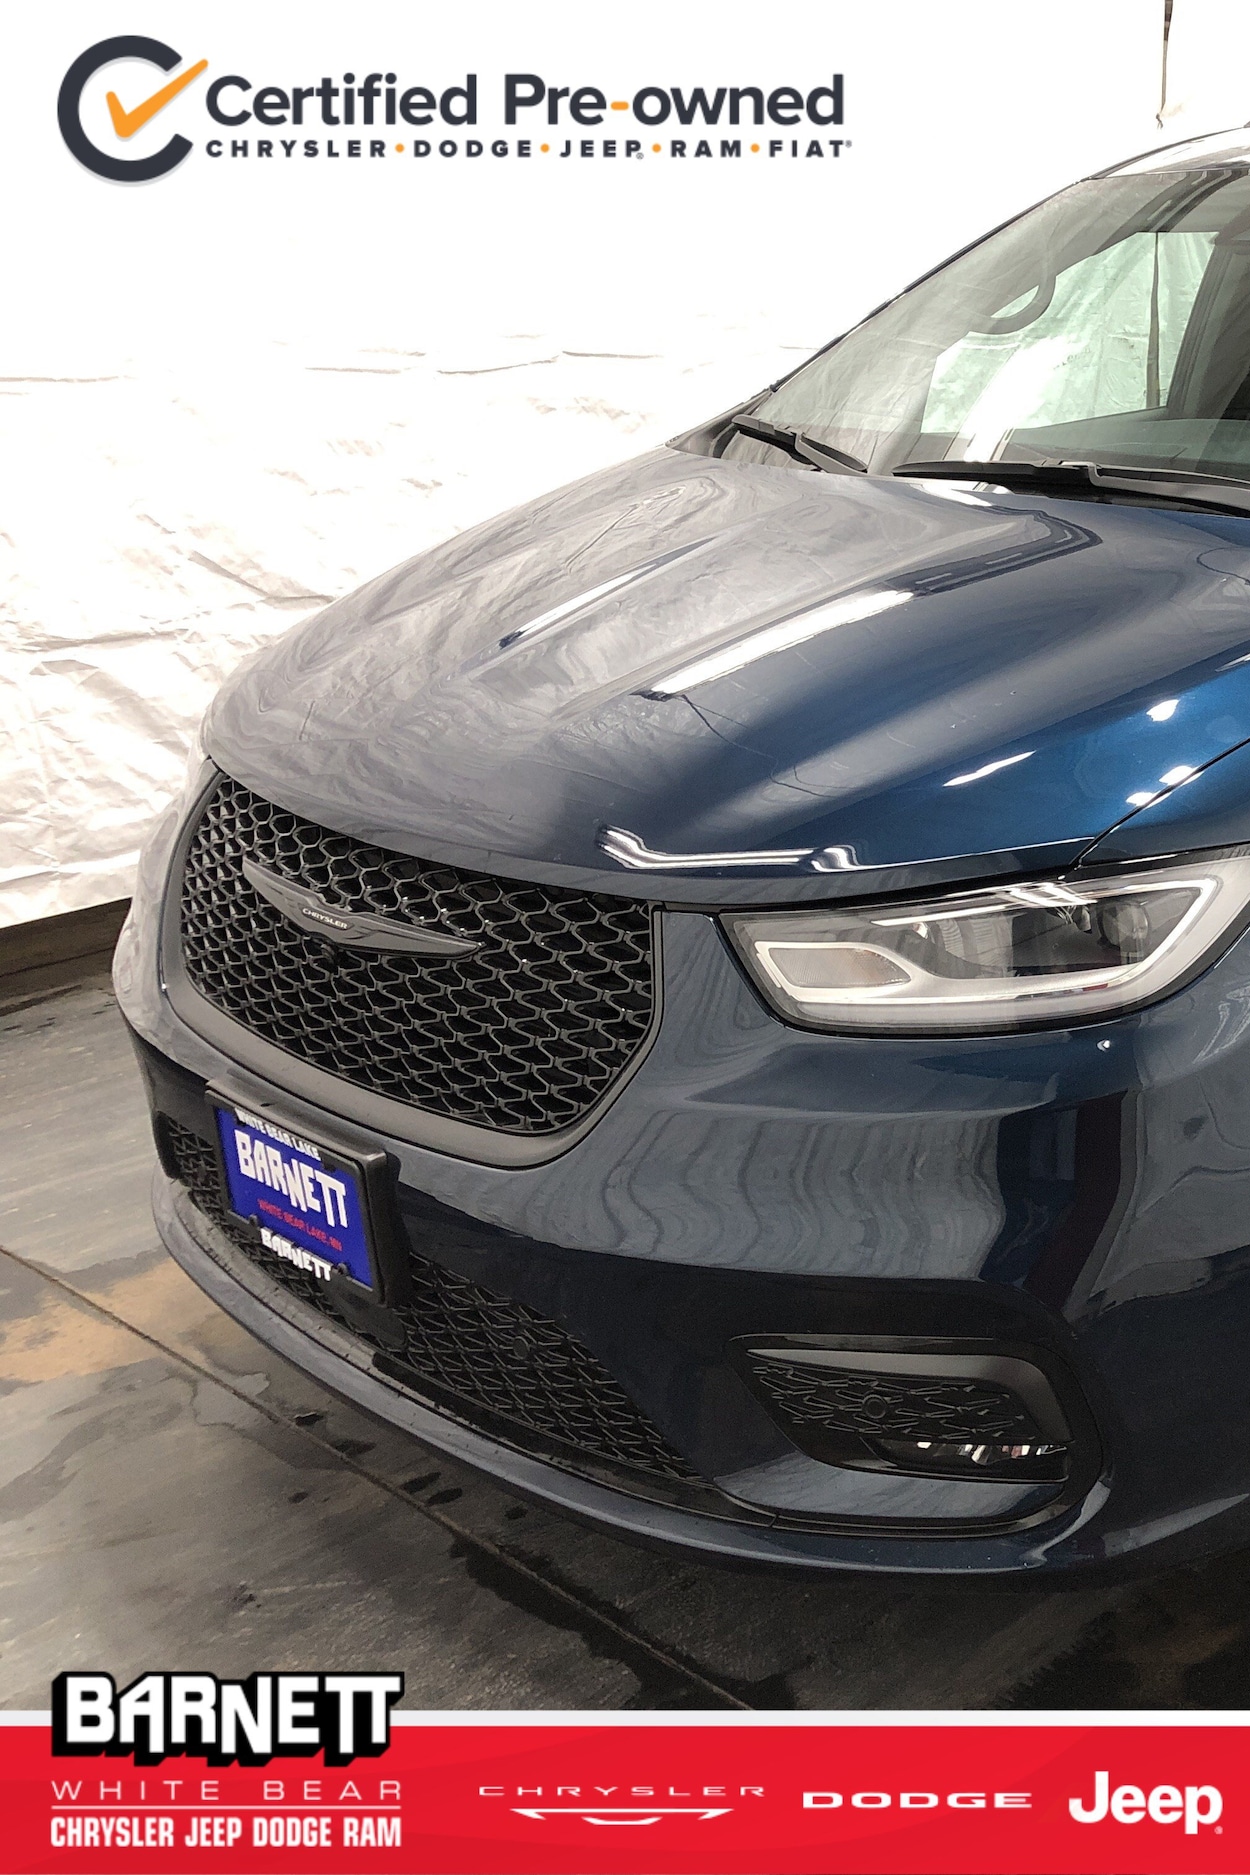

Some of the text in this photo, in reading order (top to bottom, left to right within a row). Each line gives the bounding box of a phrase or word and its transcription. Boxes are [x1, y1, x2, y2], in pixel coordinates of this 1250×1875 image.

[302, 908, 348, 930] CHRYSLER
[234, 1129, 348, 1228] BARNETT
[260, 1228, 332, 1282] BARNETT
